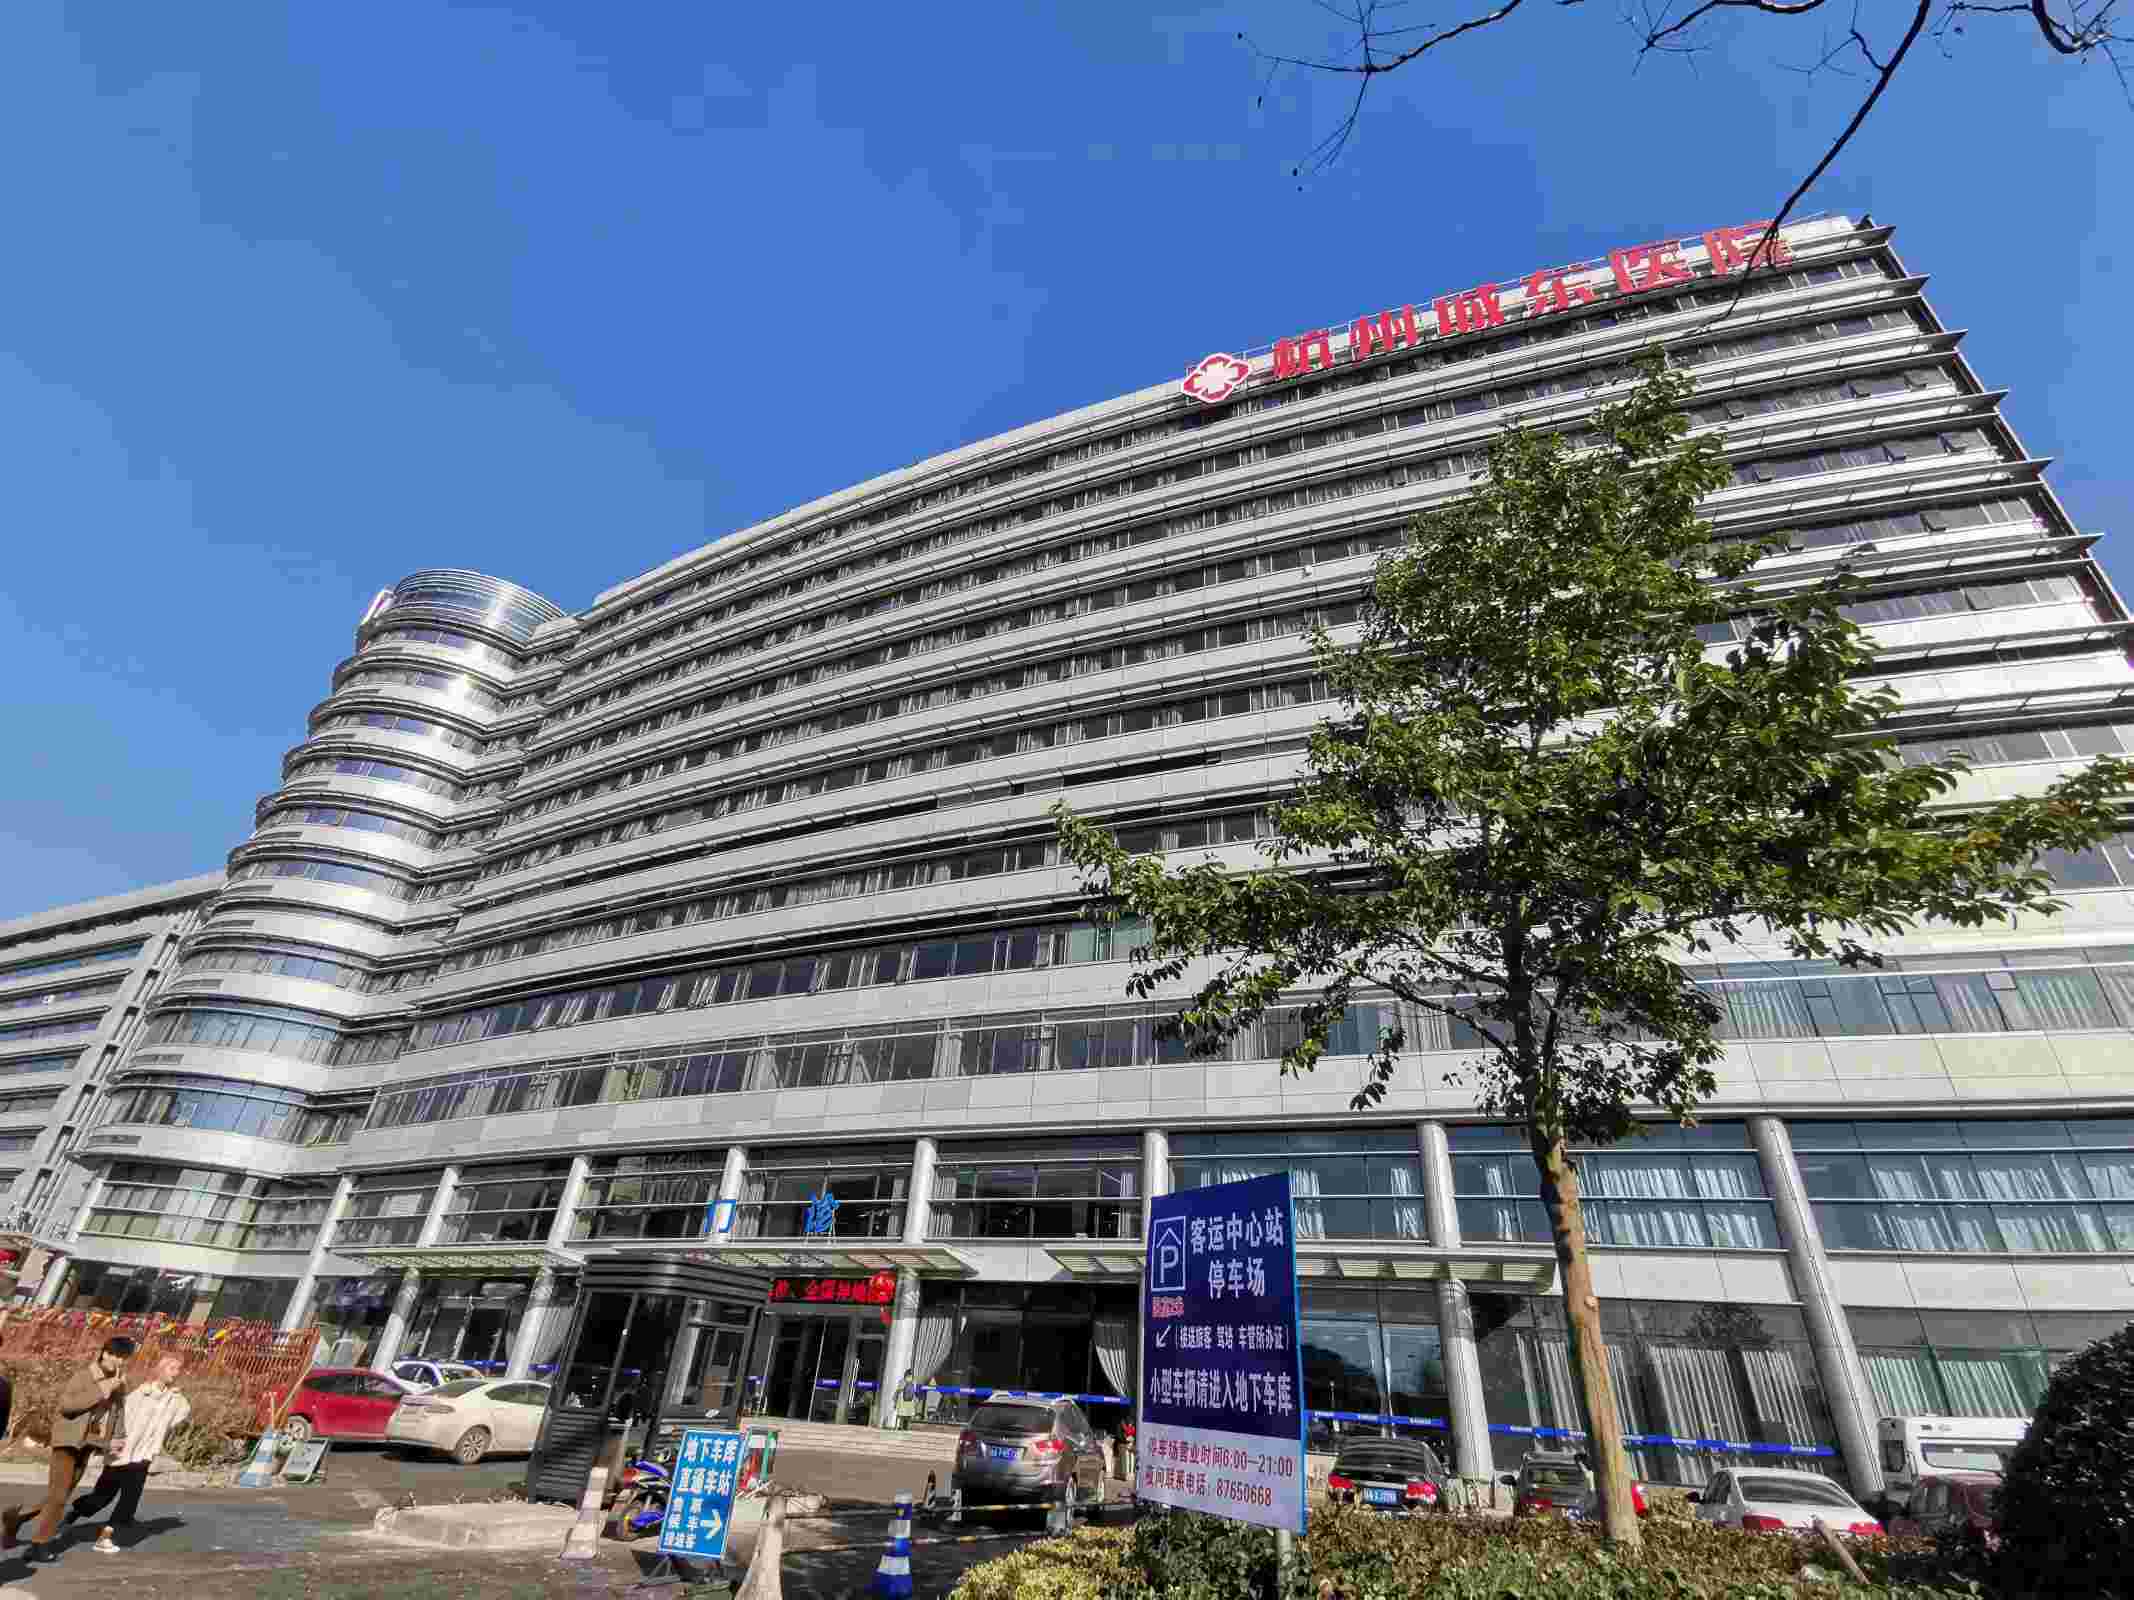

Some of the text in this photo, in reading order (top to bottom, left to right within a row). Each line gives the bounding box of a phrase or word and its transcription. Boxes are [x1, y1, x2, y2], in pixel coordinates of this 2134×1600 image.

[1272, 218, 1793, 378] 杭州城东医院
[1190, 1206, 1284, 1254] 客运中心站
[1159, 1246, 1179, 1284] P
[1208, 1256, 1265, 1300] 停车场
[1150, 1367, 1293, 1417] 小型车辆请进入地下车库
